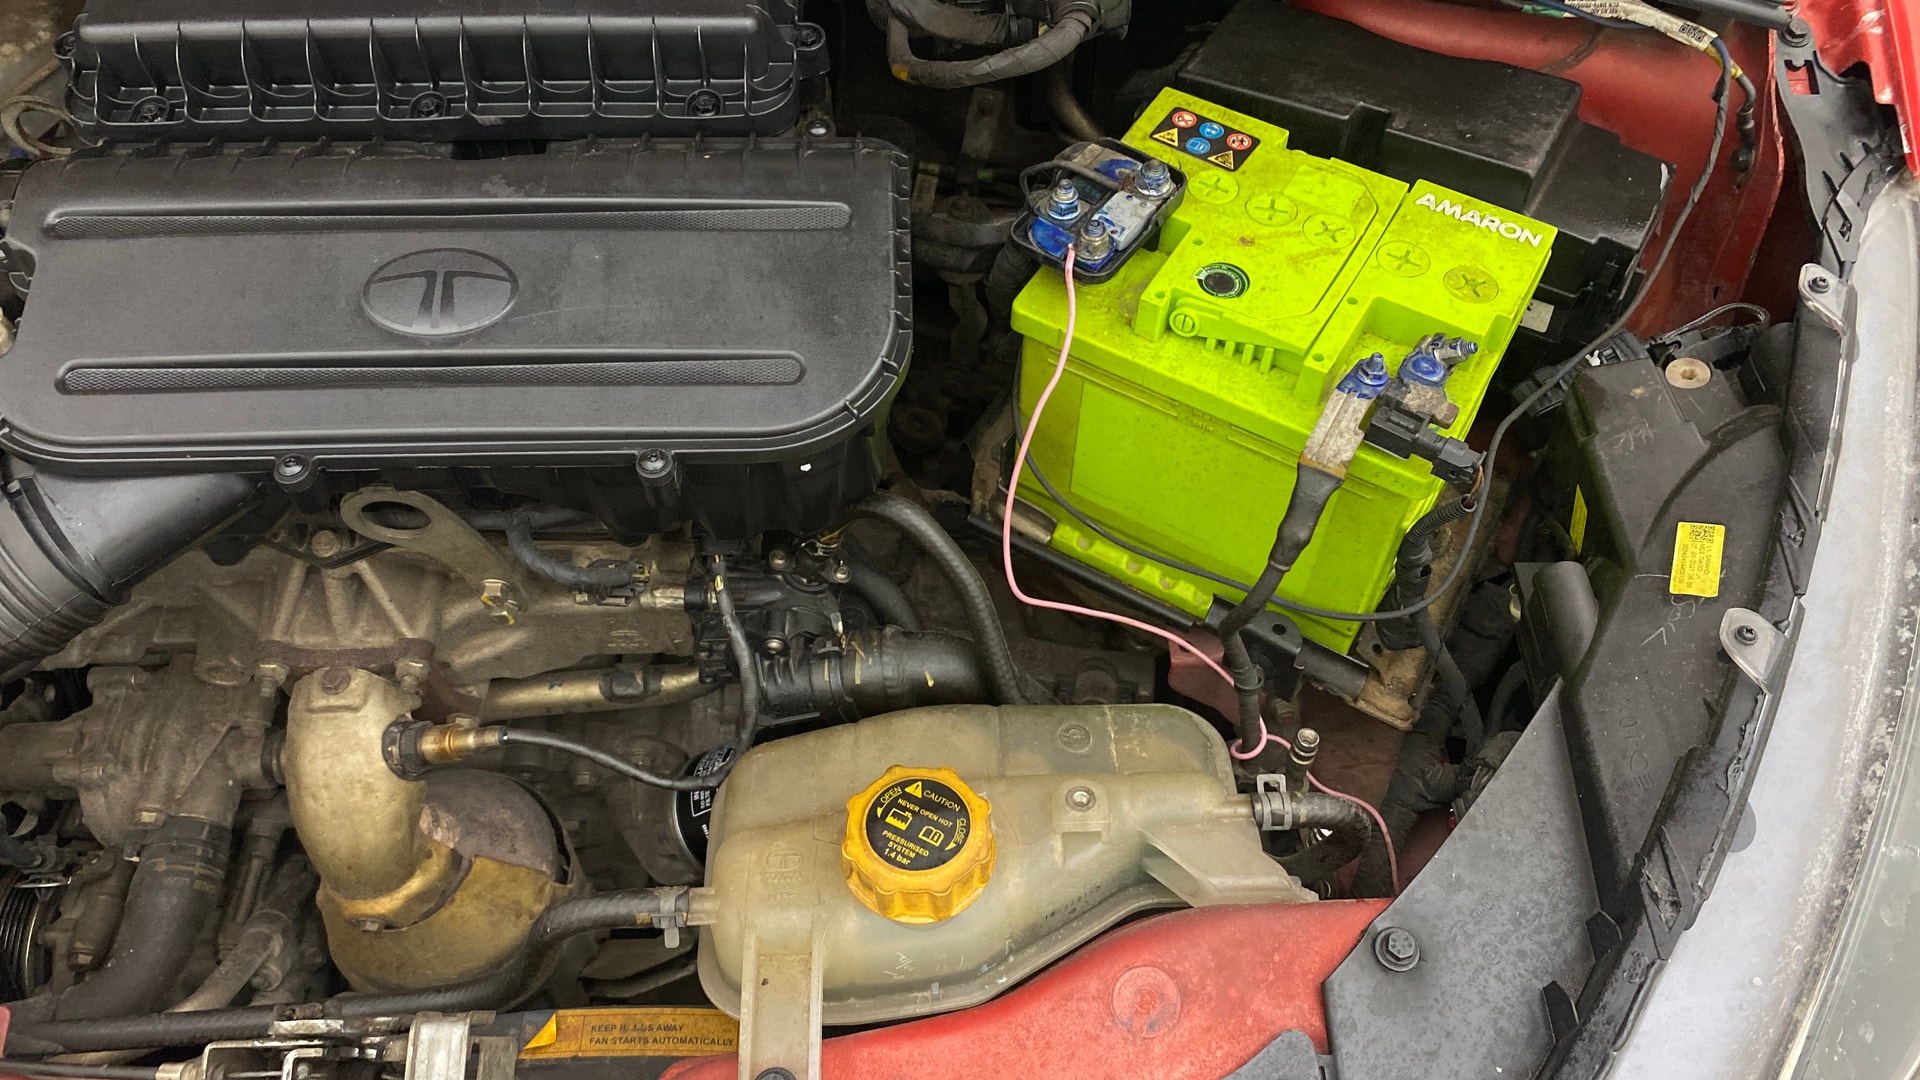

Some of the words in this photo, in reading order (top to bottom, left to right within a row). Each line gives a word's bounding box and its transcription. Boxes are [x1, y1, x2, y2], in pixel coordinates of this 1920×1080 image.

[1415, 193, 1543, 247] AMARON
[880, 785, 902, 804] OPEN
[923, 790, 961, 812] CAUTION
[897, 798, 919, 813] NEVER
[920, 808, 938, 821] OPEN
[938, 817, 953, 828] HOT
[954, 817, 967, 845] CLOSE
[882, 830, 929, 857] PRESSURISED
[887, 841, 916, 859] SYSTEM
[884, 848, 896, 859] 1.4
[896, 853, 911, 865] bar
[591, 1024, 617, 1033] KEEP
[656, 1024, 684, 1032] AWAY
[589, 1037, 608, 1045] FAN
[611, 1036, 649, 1045] STARTS
[653, 1037, 734, 1046] AUTOMATICALLY
